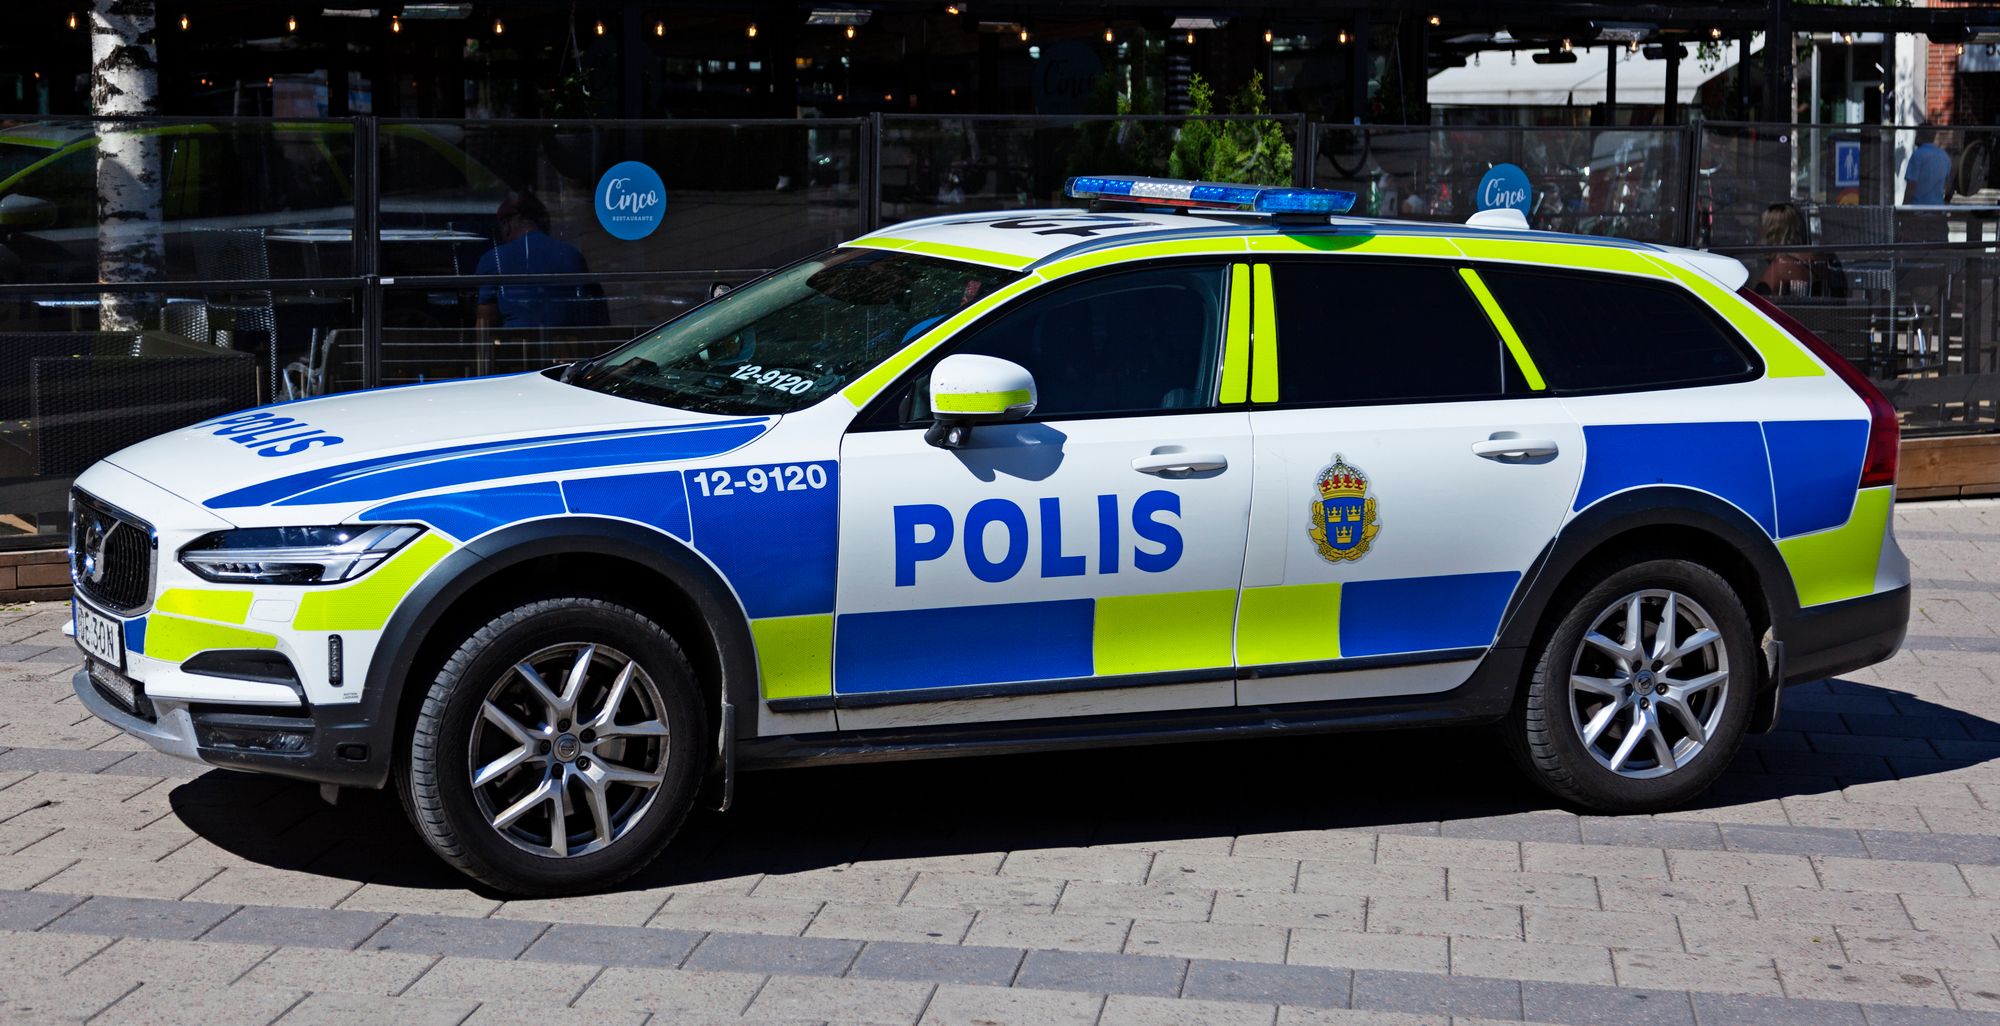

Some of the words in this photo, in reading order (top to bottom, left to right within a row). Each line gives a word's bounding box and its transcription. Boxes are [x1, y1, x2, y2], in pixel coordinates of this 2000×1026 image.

[605, 177, 659, 214] Cinco
[1485, 178, 1527, 209] Cinco
[730, 364, 813, 395] 12-9120
[192, 412, 344, 457] POLIS
[694, 464, 827, 497] 12-9120
[893, 490, 1184, 587] POLIS
